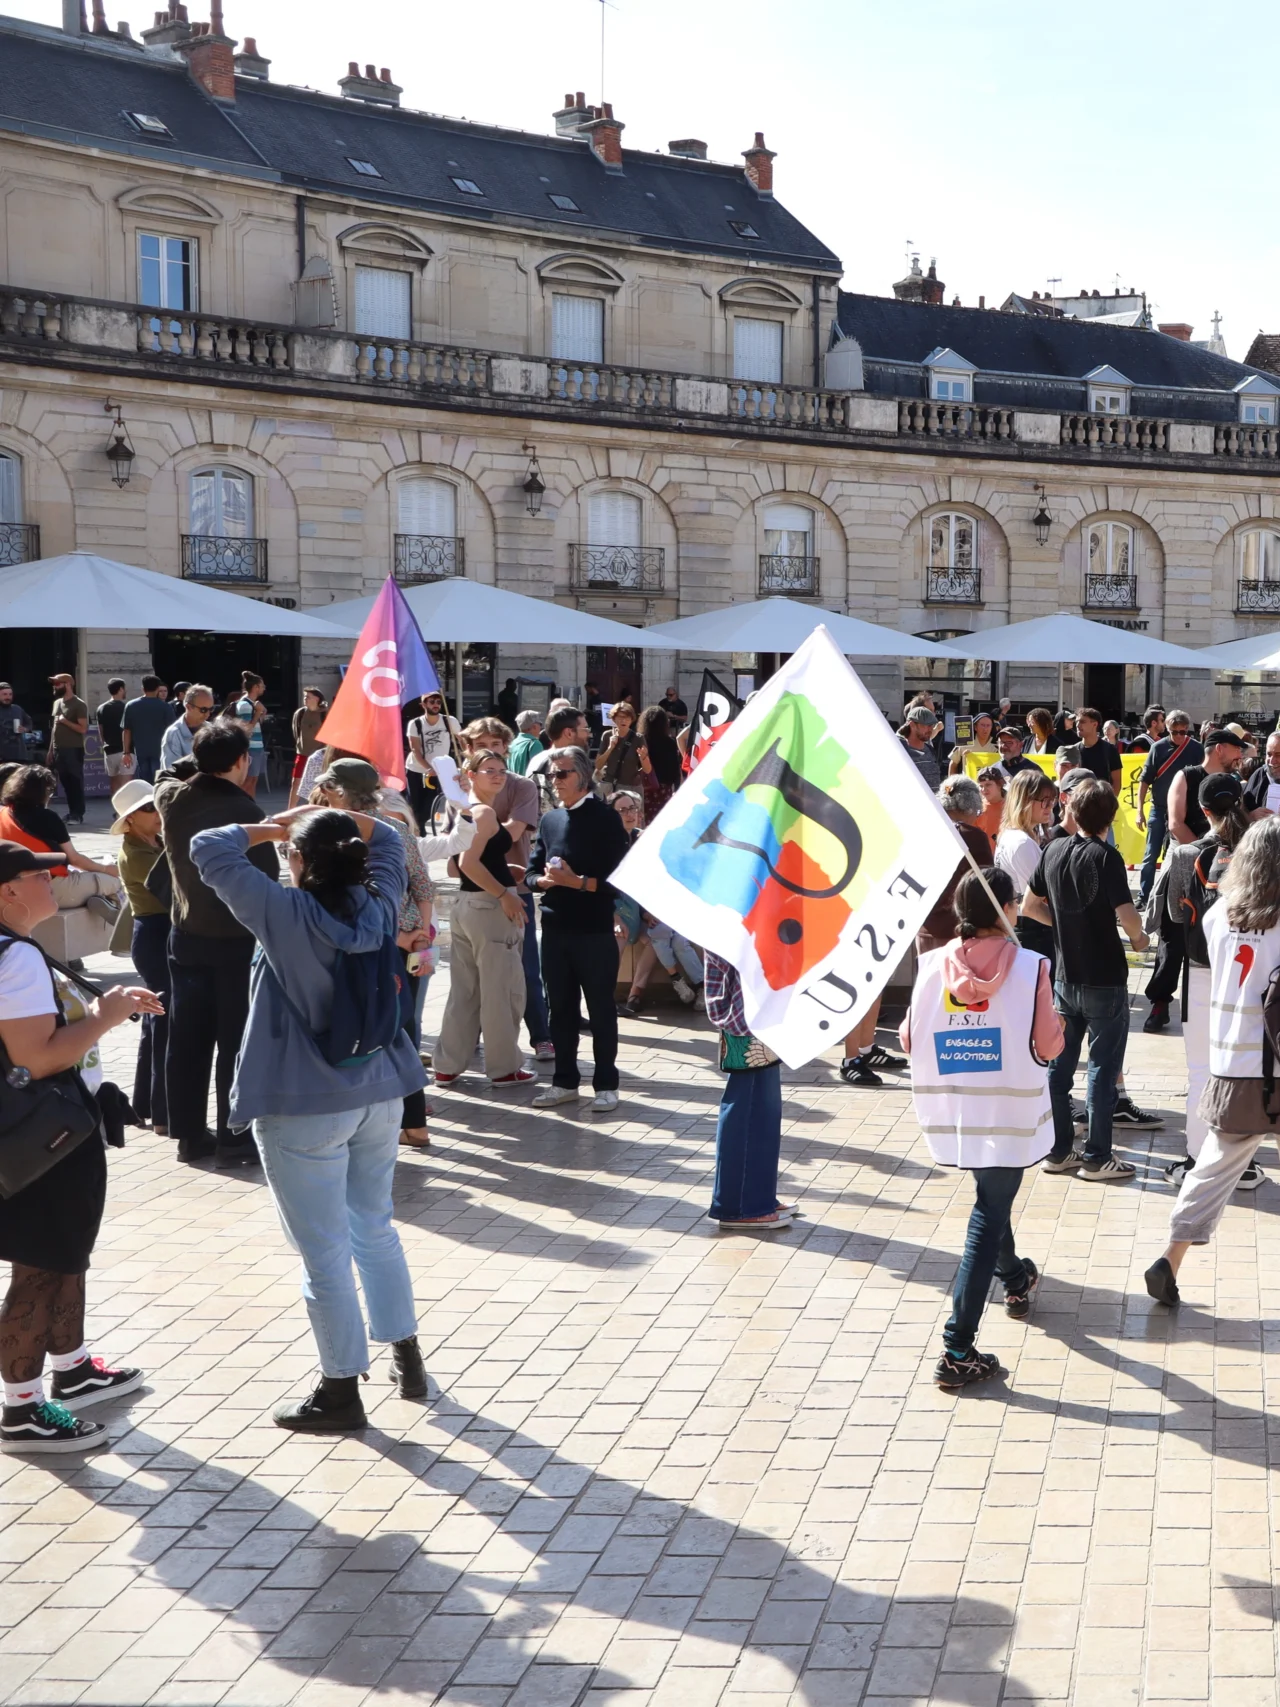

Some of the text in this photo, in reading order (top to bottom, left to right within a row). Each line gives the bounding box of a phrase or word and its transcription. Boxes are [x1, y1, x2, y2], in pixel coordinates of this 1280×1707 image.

[948, 1014, 987, 1026] F.S.U.
[940, 1052, 1000, 1061] AU QUOTIDIEN
